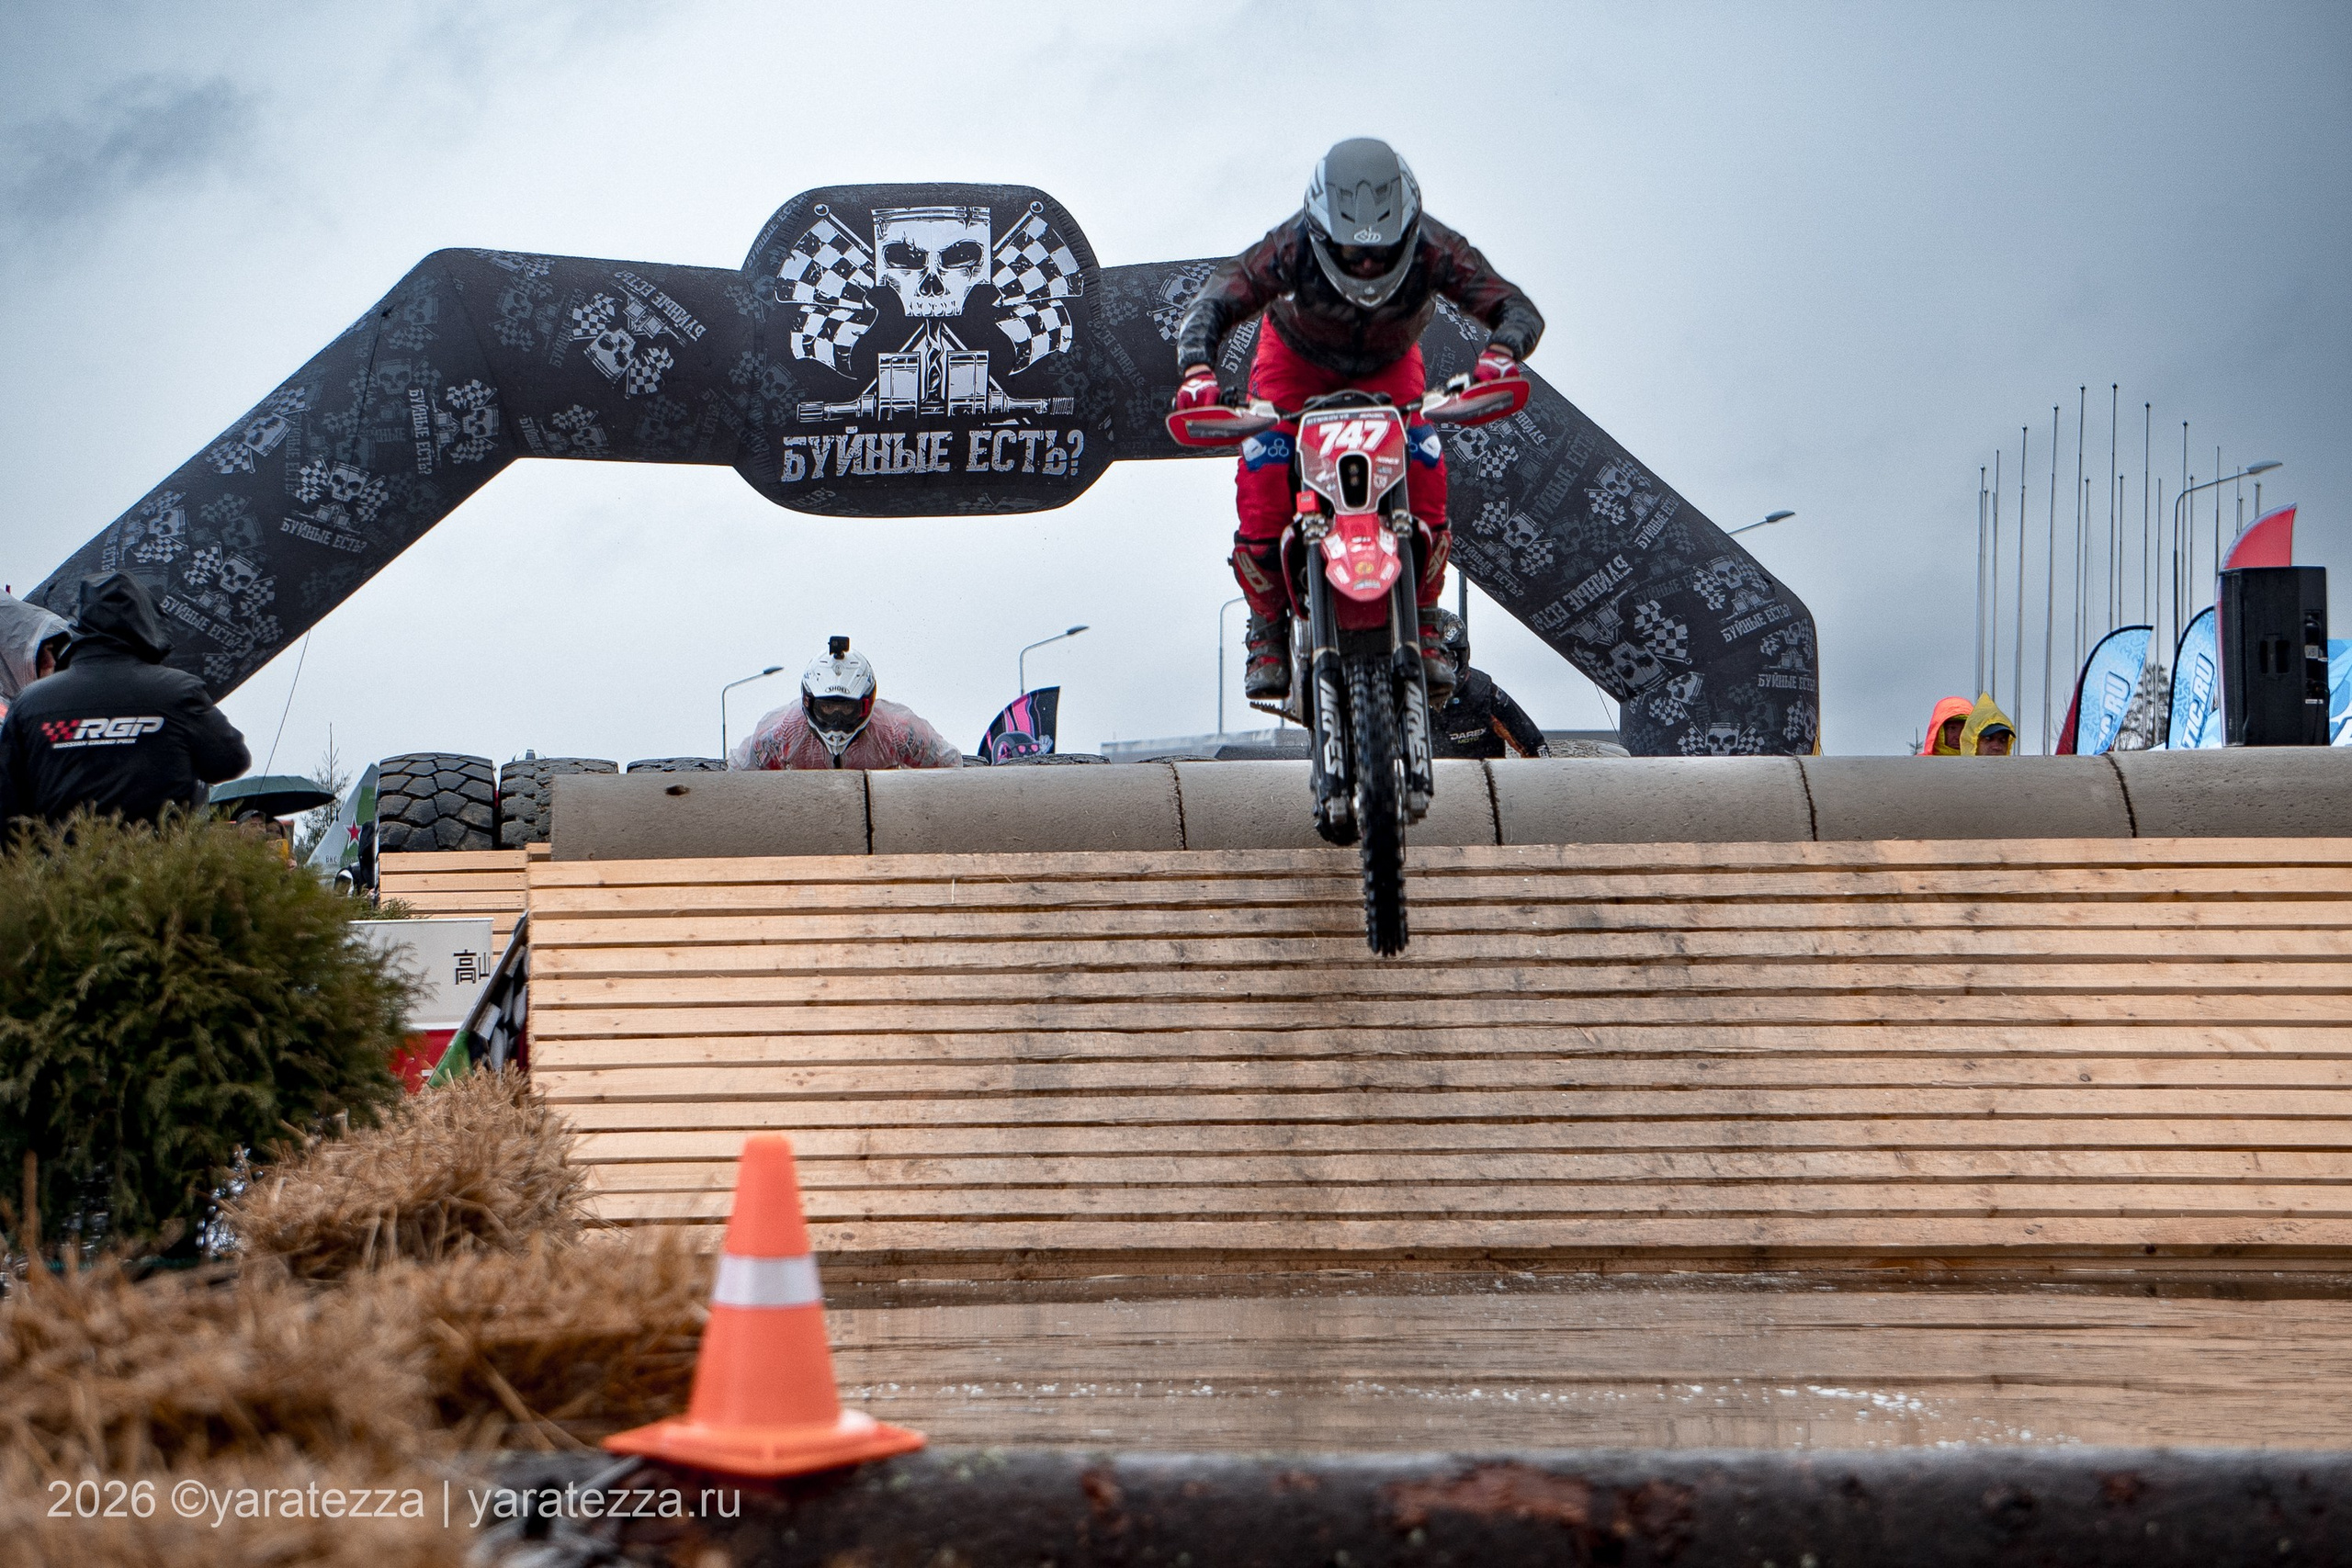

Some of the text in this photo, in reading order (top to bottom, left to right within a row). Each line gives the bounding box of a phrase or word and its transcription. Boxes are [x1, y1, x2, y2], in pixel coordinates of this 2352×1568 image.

[650, 291, 707, 342] БУЙНЫЕ
[1220, 316, 1262, 374] БУЙНЫ
[408, 388, 433, 475] БУЙНЫЕ ЕСТЬ?
[1318, 420, 1389, 457] 747
[781, 425, 953, 482] БУЙНЫЕ
[966, 429, 1085, 477] ЕСТЬ?
[279, 516, 333, 545] БУЙНЫЕ
[332, 534, 368, 553] ЕСТЬ?
[1634, 510, 1669, 550] БУЙНЫЕ
[1453, 535, 1525, 598] БУЙНЫЕ ЕСТЬ?
[1563, 554, 1634, 613] БУЙНЫЕ
[159, 594, 243, 649] БУЙНЫЕ ЕСТЬ?
[1720, 604, 1792, 643] БУЙНЫЕ ЕСТЬ?
[1758, 671, 1797, 689] БУЙНЫЕ
[52, 740, 88, 750] RUSSIAN
[74, 716, 164, 739] RGP
[1449, 728, 1487, 740] DAREX
[1457, 737, 1480, 745] MOTO
